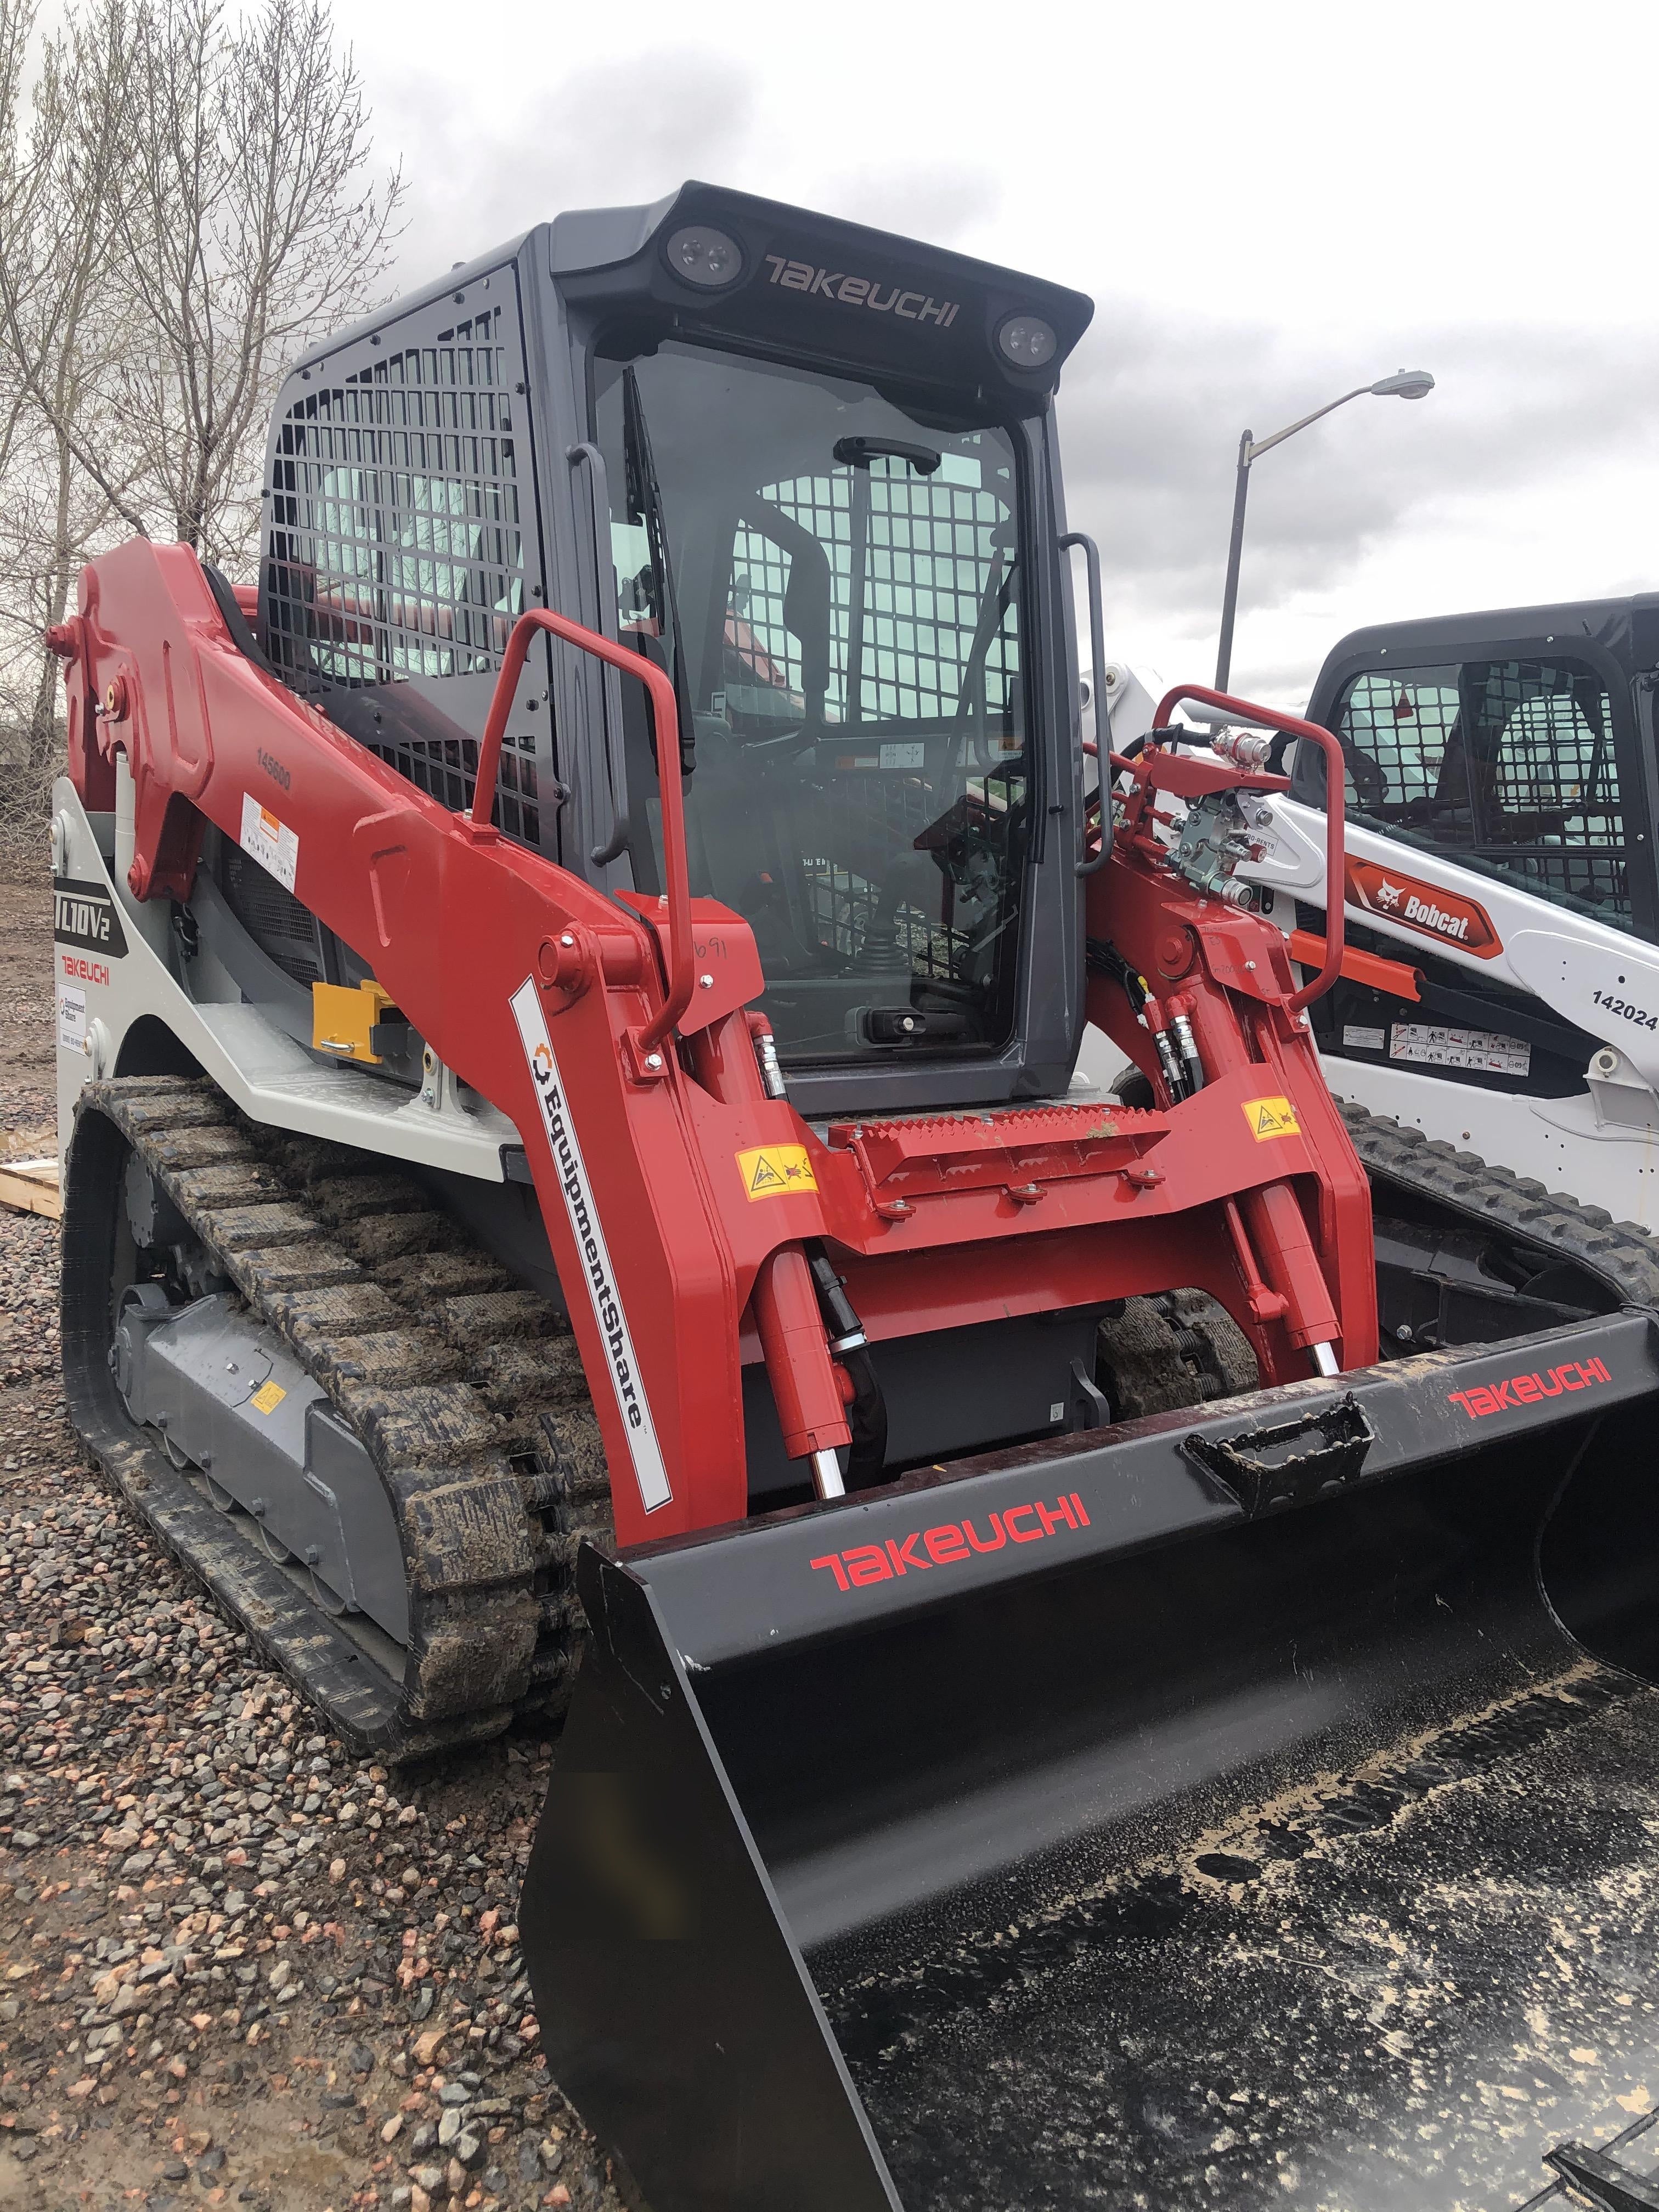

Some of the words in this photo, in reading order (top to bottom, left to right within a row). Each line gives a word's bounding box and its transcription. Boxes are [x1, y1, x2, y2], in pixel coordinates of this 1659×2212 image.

[765, 254, 960, 327] TAKEUCHI
[1404, 895, 1469, 939] Bobcat
[61, 955, 109, 986] TAKEUCHI
[1593, 990, 1658, 1031] 142024
[544, 1084, 642, 1429] EquipmentShare
[1448, 1357, 1612, 1418] TAKEUCHI
[810, 1493, 1091, 1591] TAKEUCHI
